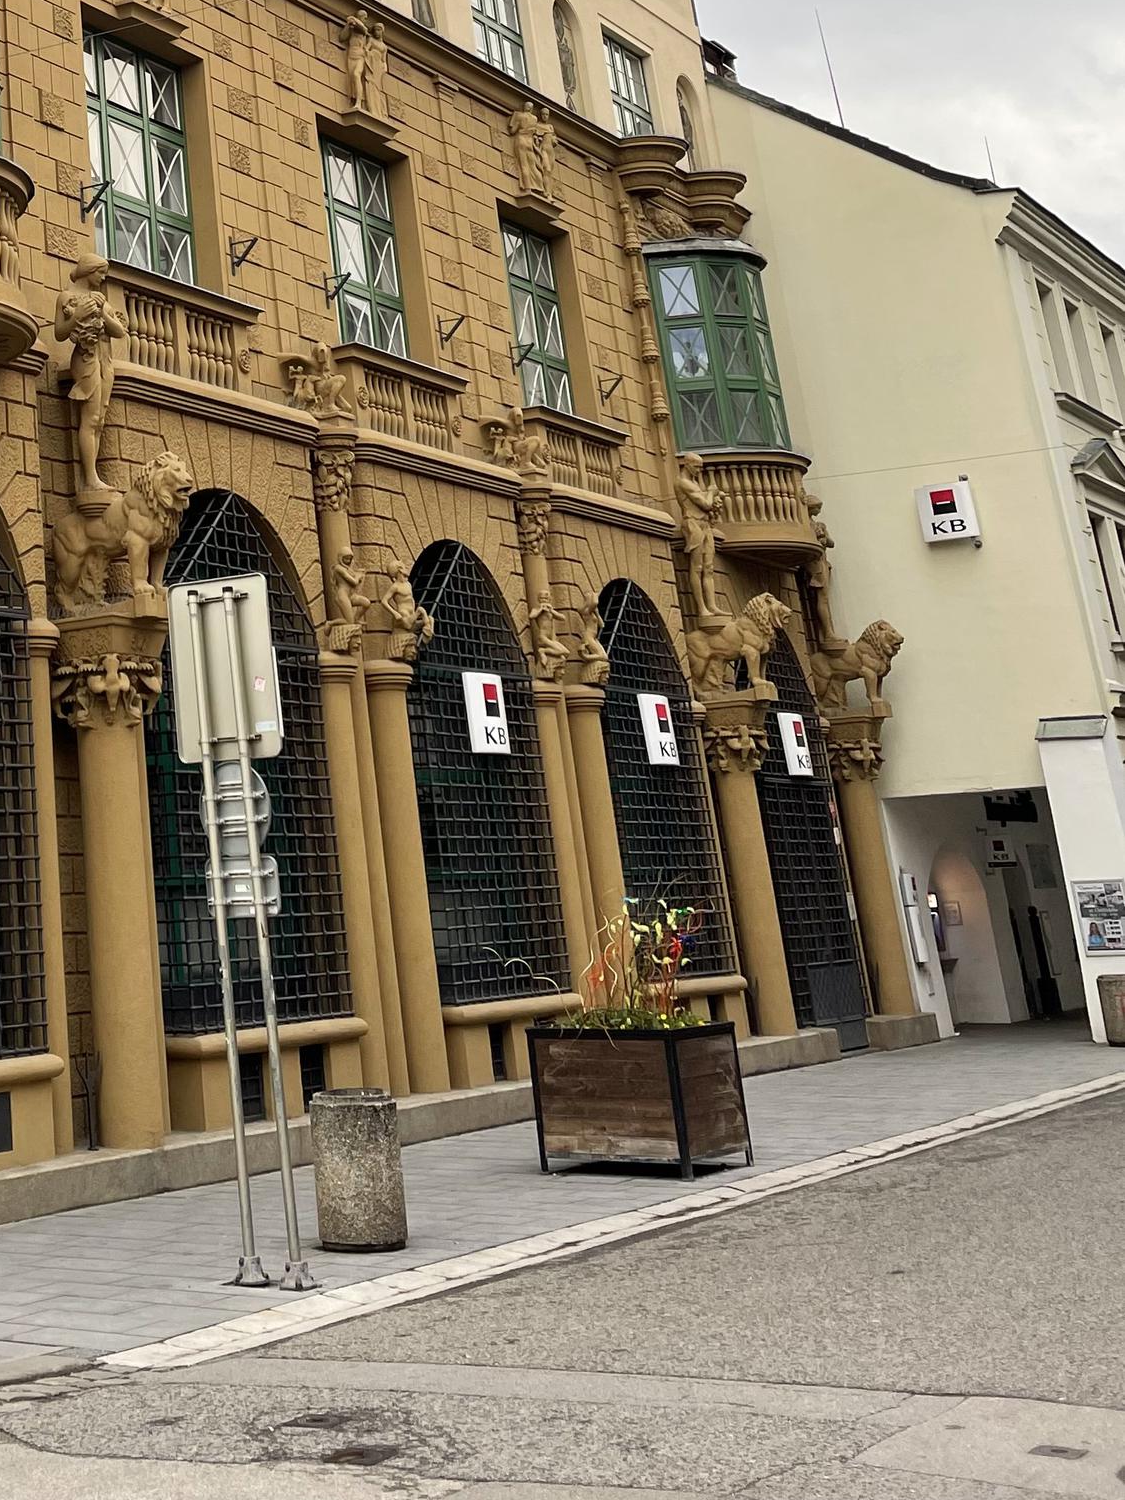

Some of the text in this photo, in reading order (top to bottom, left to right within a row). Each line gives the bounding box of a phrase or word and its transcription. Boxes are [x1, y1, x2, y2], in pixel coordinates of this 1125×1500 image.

[931, 519, 966, 535] KB
[484, 726, 506, 745] KB
[659, 741, 676, 757] KB
[796, 754, 811, 768] KB
